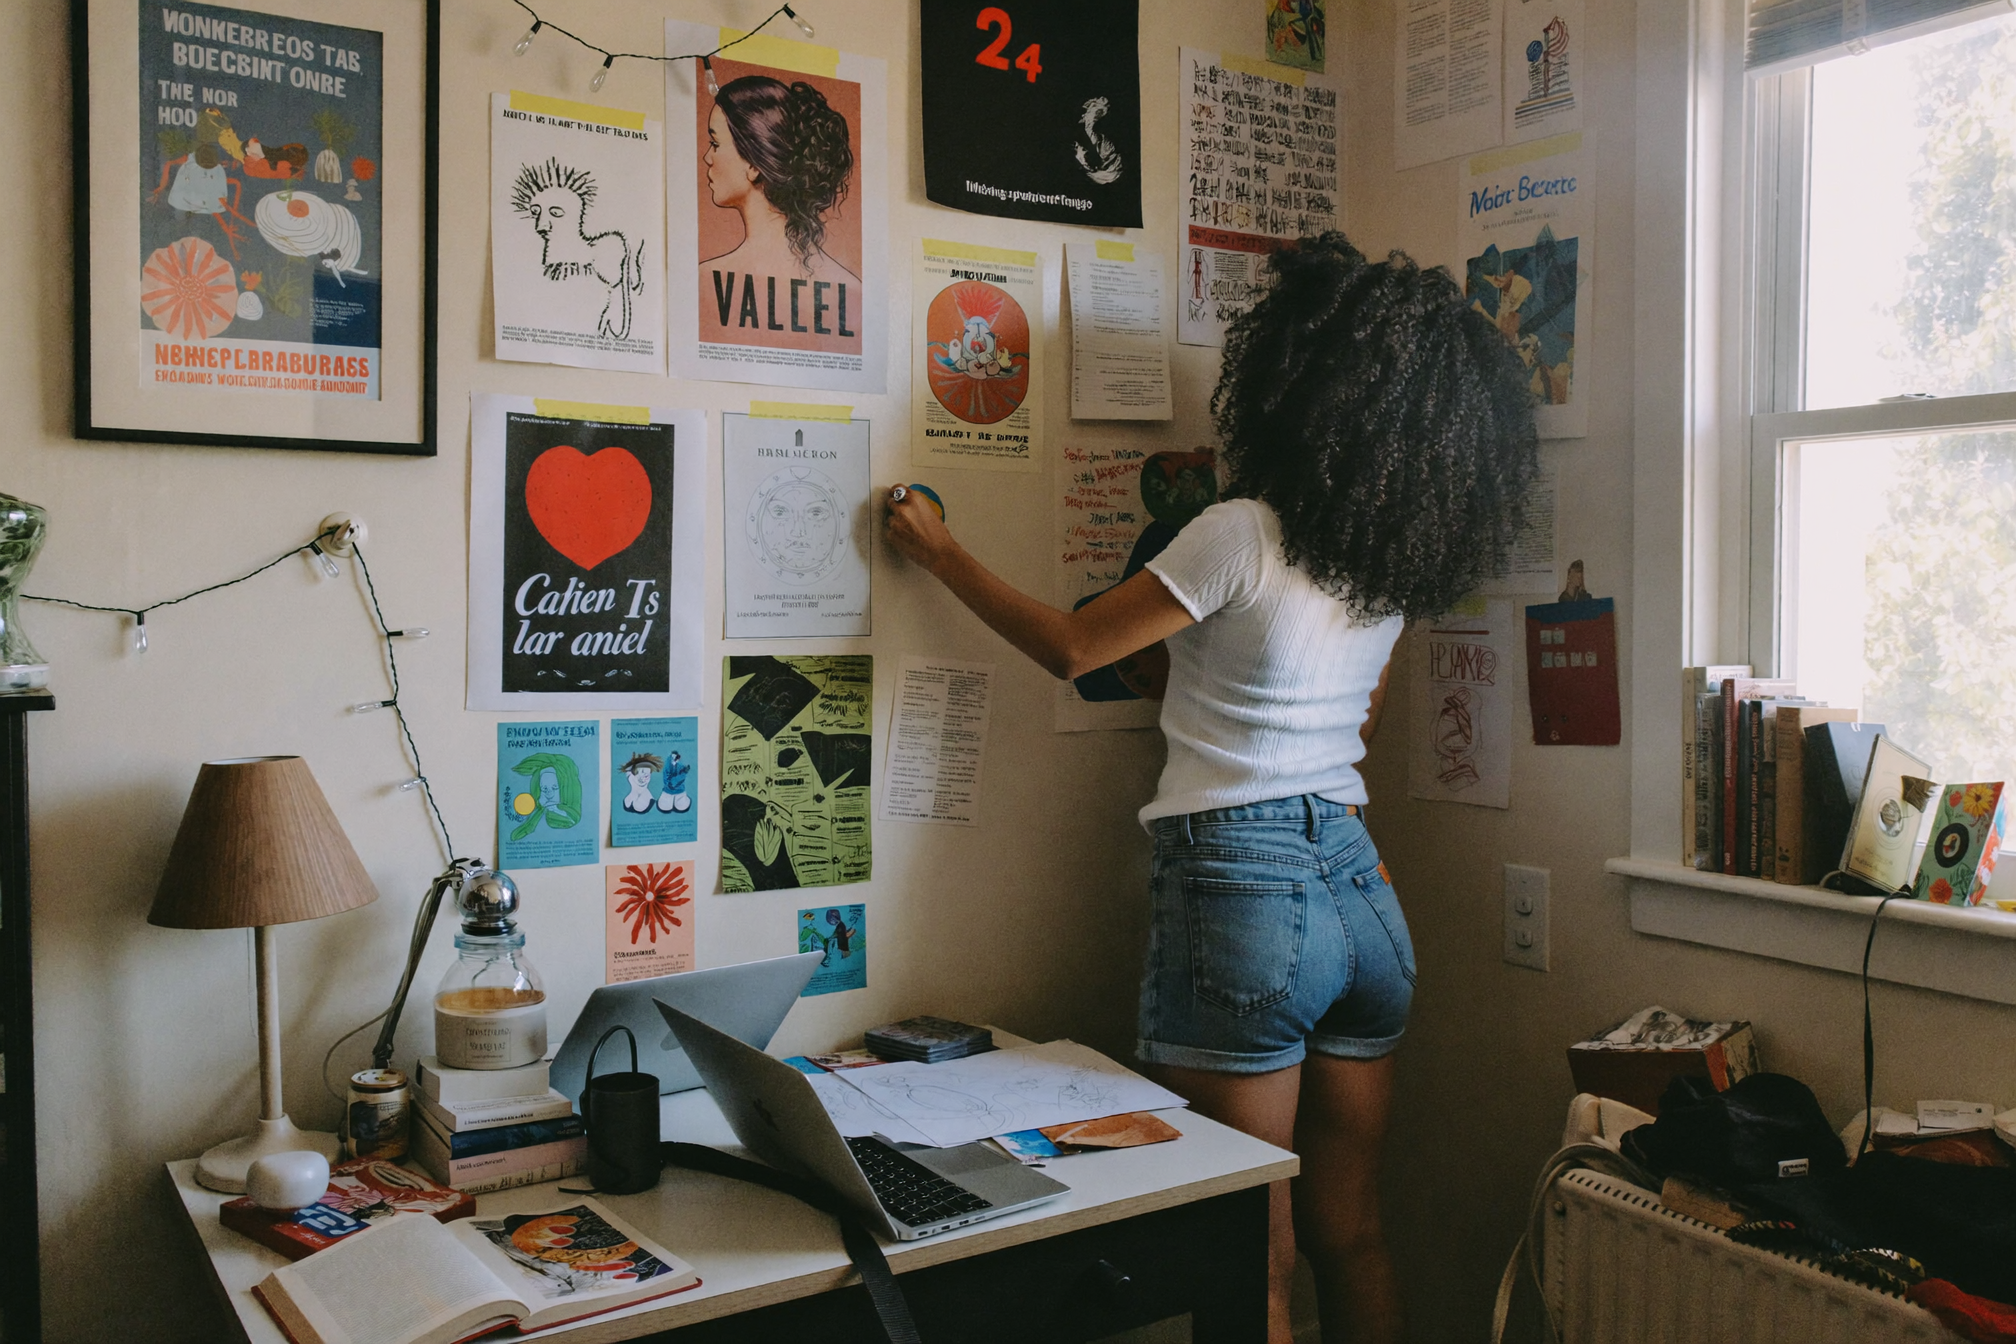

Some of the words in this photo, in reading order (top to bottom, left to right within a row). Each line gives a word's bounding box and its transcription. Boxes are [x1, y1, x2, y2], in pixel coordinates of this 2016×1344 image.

[202, 86, 238, 108] NOR
[712, 269, 855, 338] VALCEL
[624, 578, 661, 619] Ts
[570, 619, 653, 656] aniel
